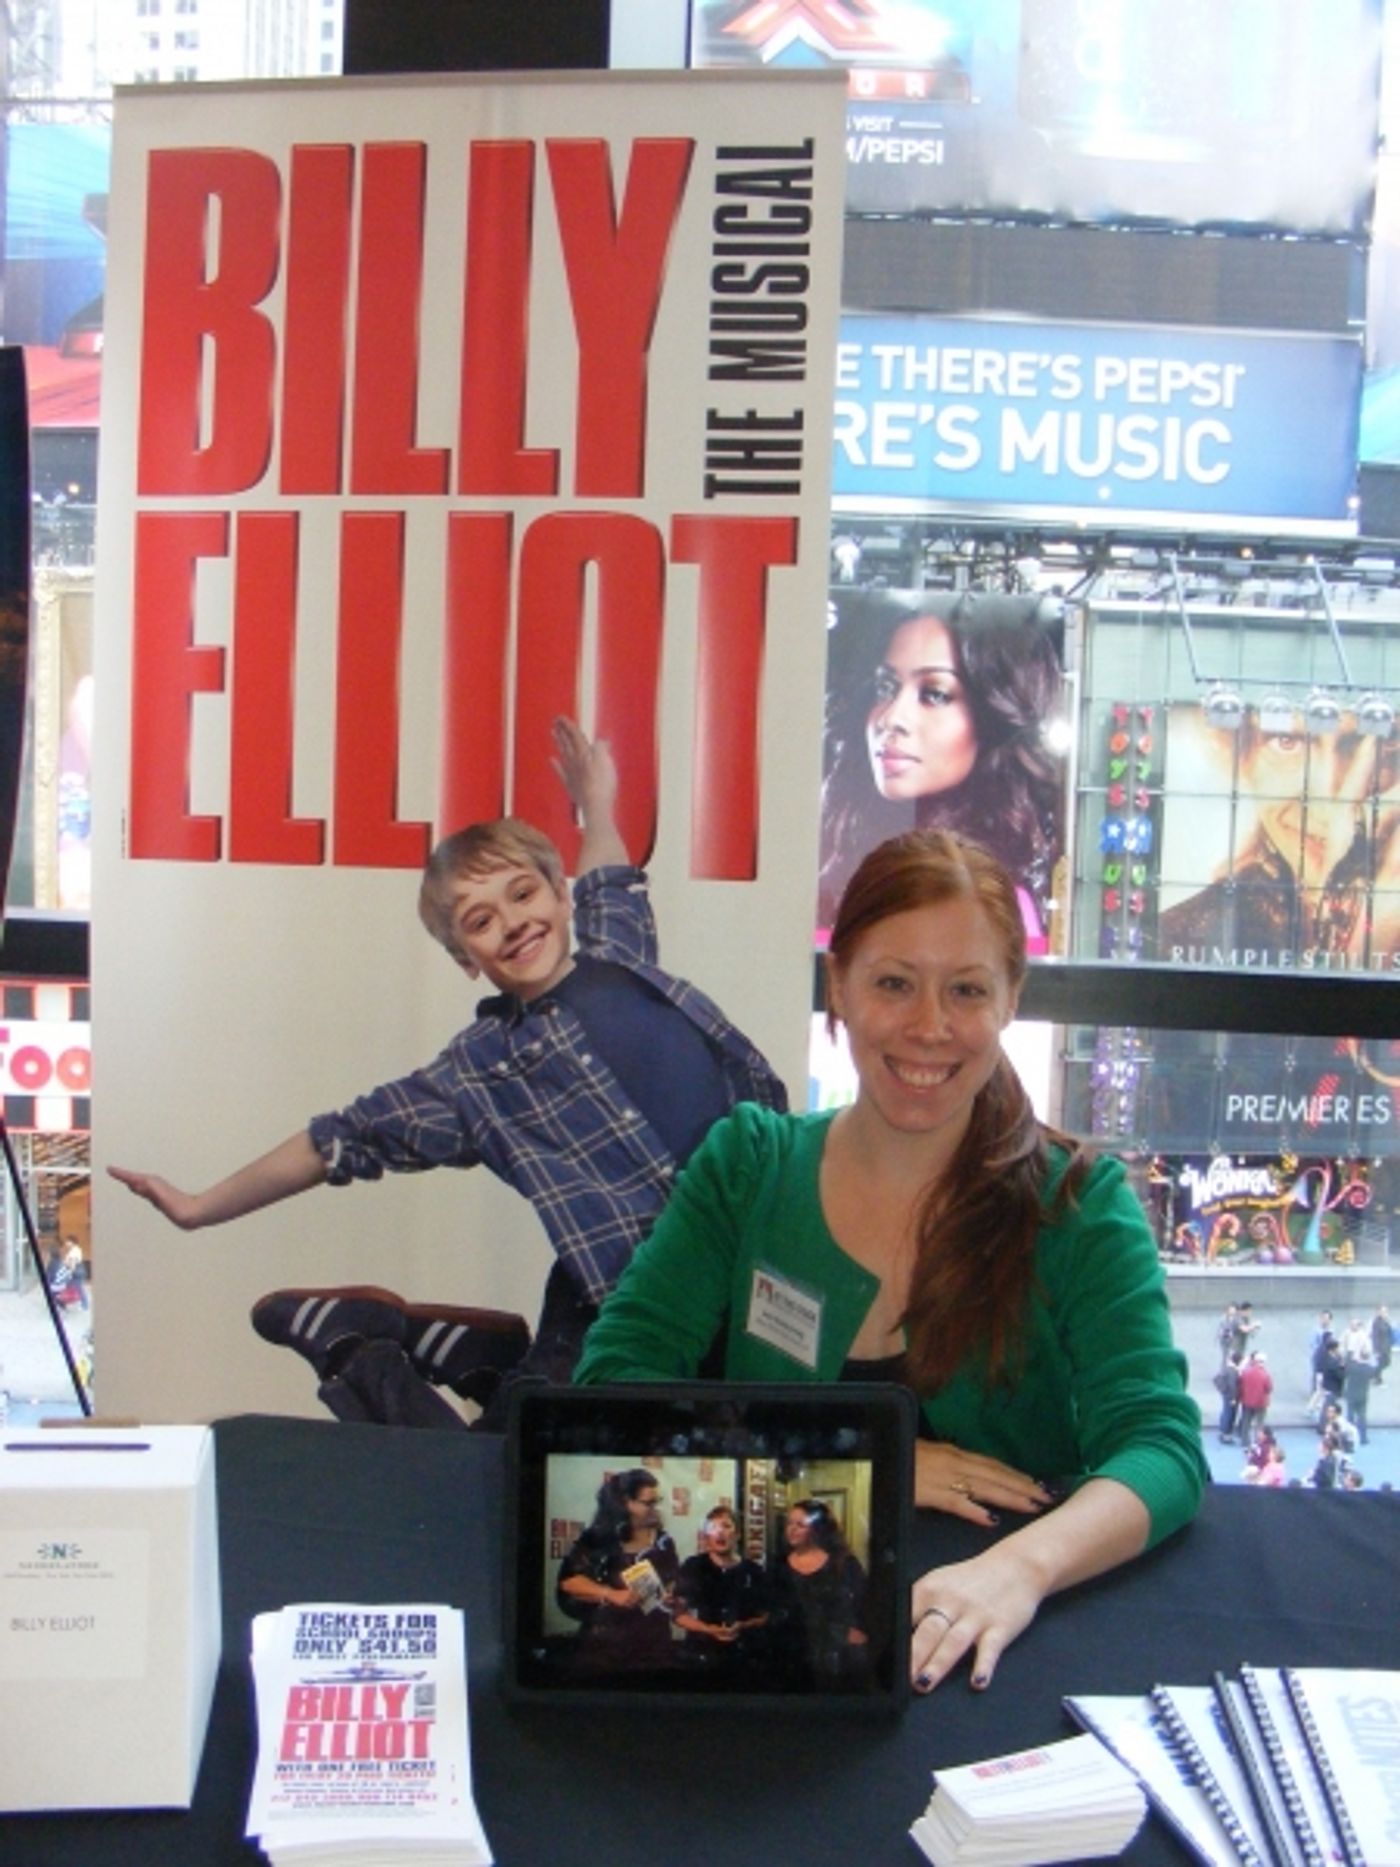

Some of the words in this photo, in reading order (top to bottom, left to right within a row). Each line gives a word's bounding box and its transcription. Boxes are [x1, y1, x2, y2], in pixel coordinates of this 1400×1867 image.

[708, 137, 815, 381] MUSICAL
[136, 137, 696, 498] BILLY
[872, 346, 1083, 399] THERE'S
[703, 408, 804, 499] THE
[1000, 407, 1232, 484] MUSIC
[129, 510, 800, 881] ELLIOT
[10, 1617, 48, 1632] BILLY
[49, 1614, 95, 1632] ELLIOT
[299, 1612, 388, 1628] TICKETS
[396, 1614, 437, 1629] FOR
[293, 1639, 347, 1654] ONLY
[286, 1684, 411, 1721] BILLY
[280, 1720, 436, 1761] ELLIOT
[389, 1761, 437, 1771] TICKET
